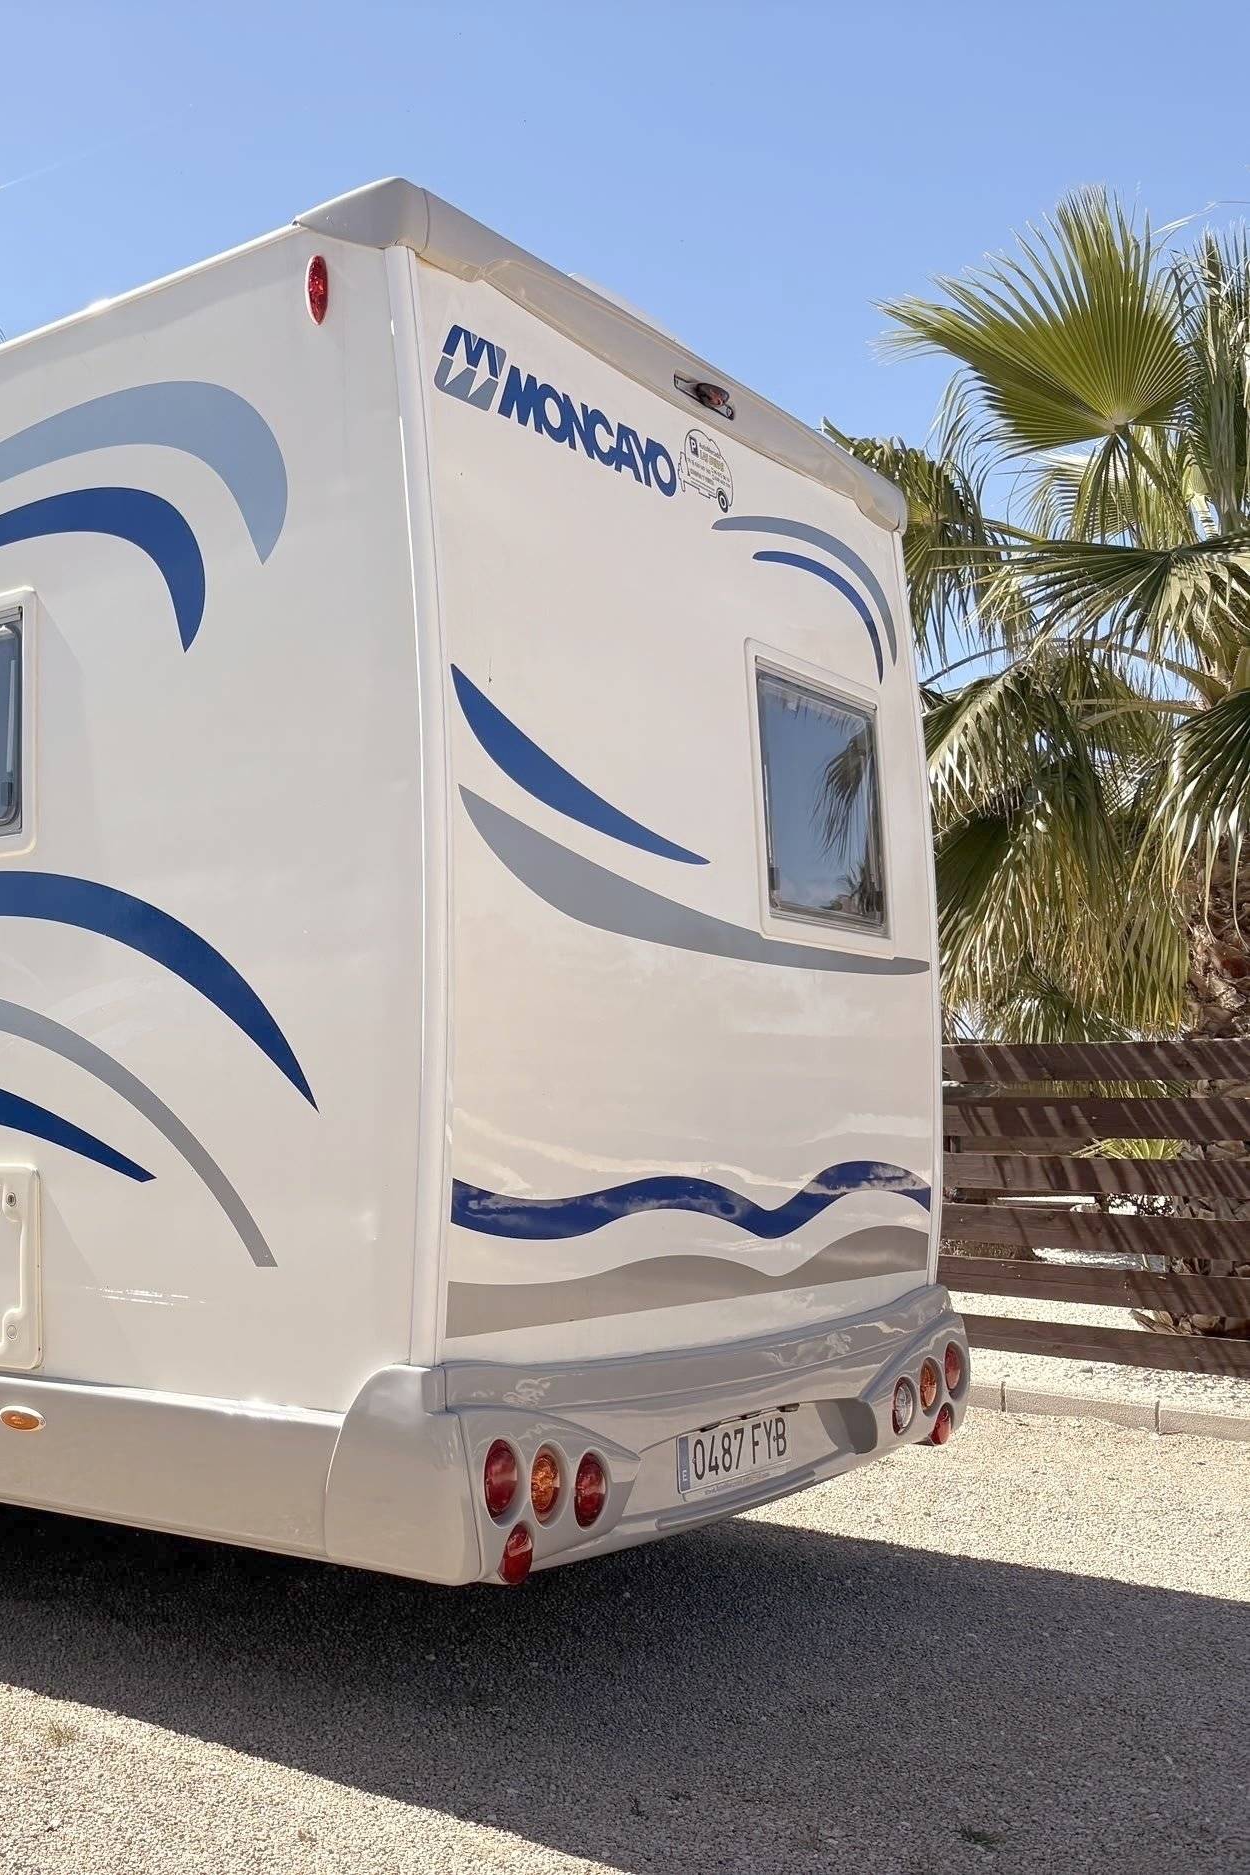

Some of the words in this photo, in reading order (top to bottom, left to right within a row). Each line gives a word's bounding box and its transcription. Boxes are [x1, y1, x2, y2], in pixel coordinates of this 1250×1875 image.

[498, 365, 677, 497] MONCAYO
[693, 1428, 745, 1480] 0487
[751, 1417, 787, 1465] FYB
